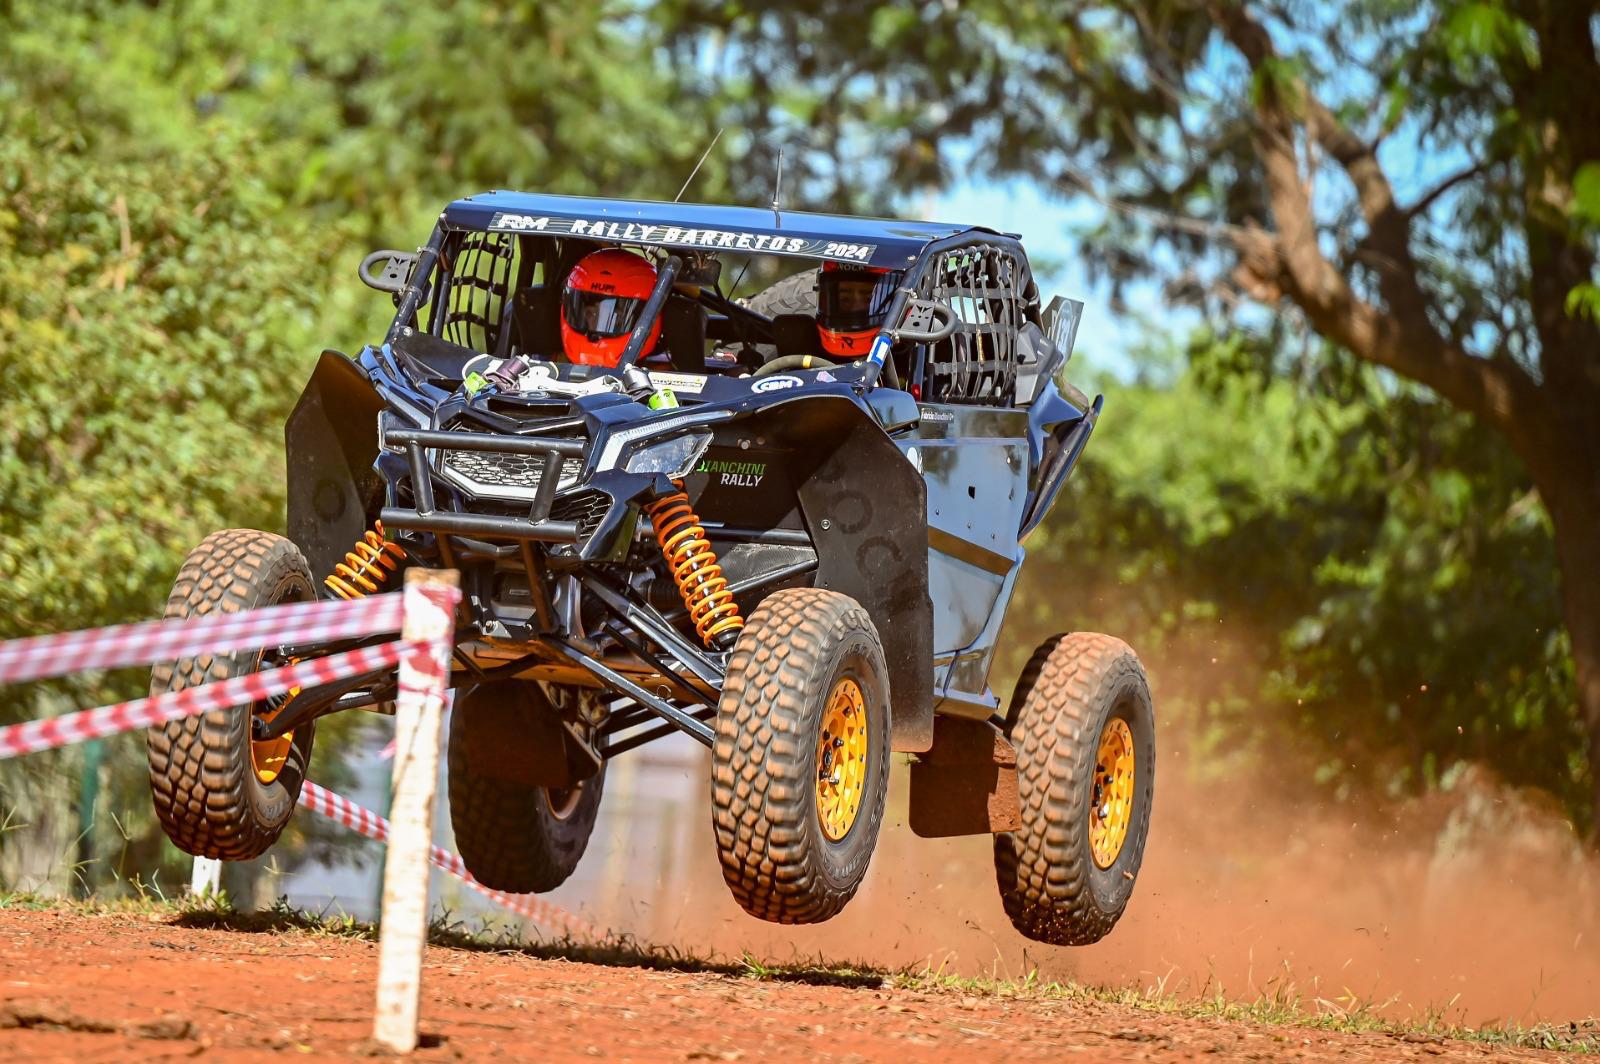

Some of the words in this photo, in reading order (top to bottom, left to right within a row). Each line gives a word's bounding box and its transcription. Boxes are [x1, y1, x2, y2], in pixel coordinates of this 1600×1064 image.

[570, 219, 657, 241] RALLY
[663, 226, 804, 252] BARRETOS
[824, 243, 869, 260] 2024
[720, 473, 763, 487] RALLY
